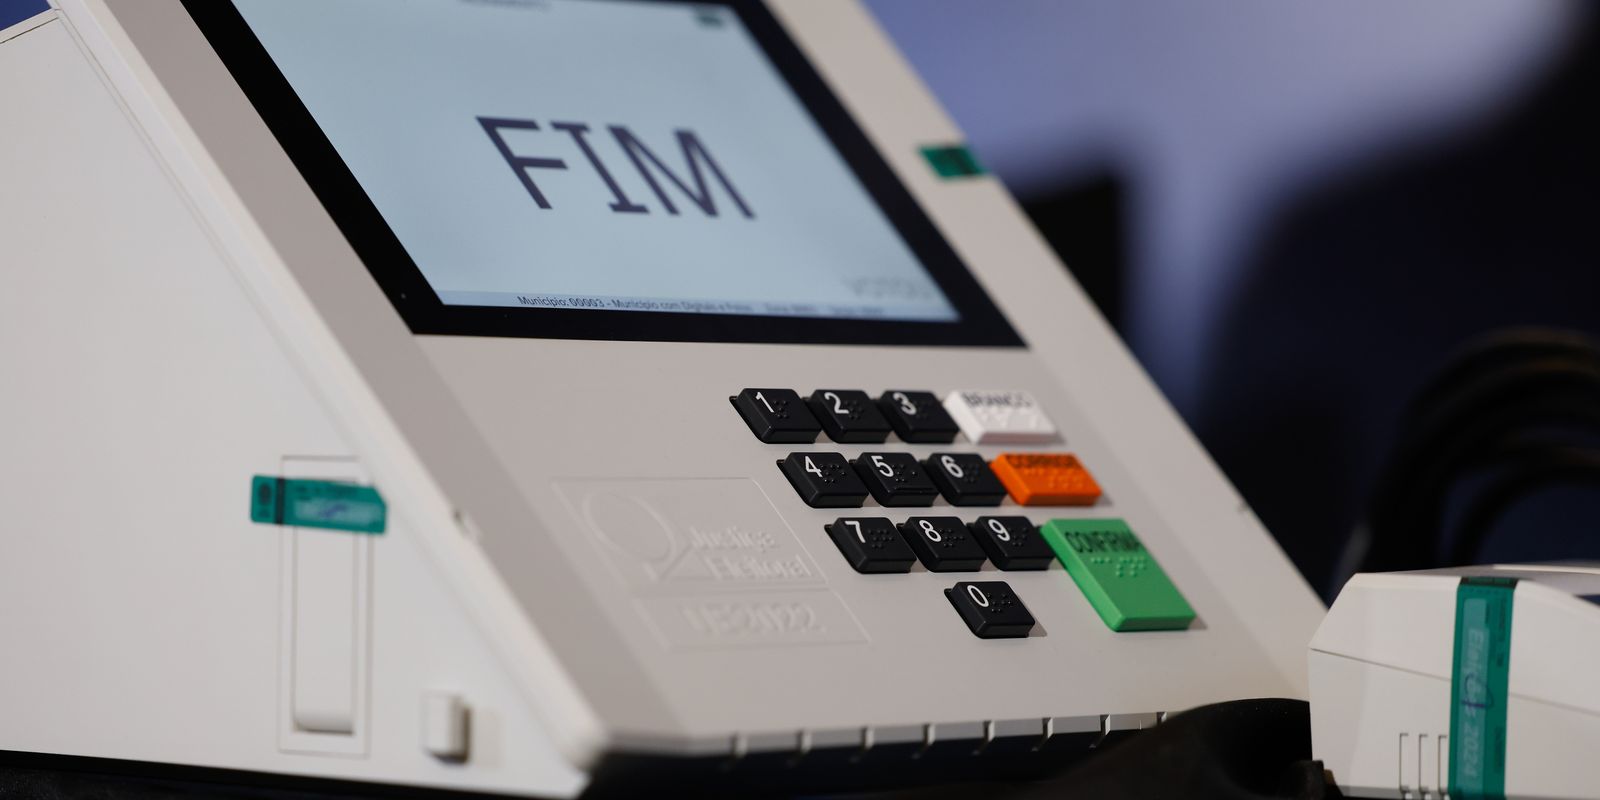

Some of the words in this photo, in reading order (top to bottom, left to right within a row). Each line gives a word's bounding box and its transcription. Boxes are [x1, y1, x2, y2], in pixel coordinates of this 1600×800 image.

[475, 115, 756, 220] FIM
[517, 296, 569, 307] Município:
[569, 298, 605, 308] 00003
[754, 391, 776, 413] 1
[824, 392, 850, 414] 2
[892, 393, 917, 415] 3
[804, 455, 823, 478] 4
[870, 455, 894, 478] 5
[941, 455, 964, 478] 6
[844, 520, 866, 544] 7
[919, 519, 942, 543] 8
[988, 518, 1010, 542] 9
[967, 584, 990, 608] 0
